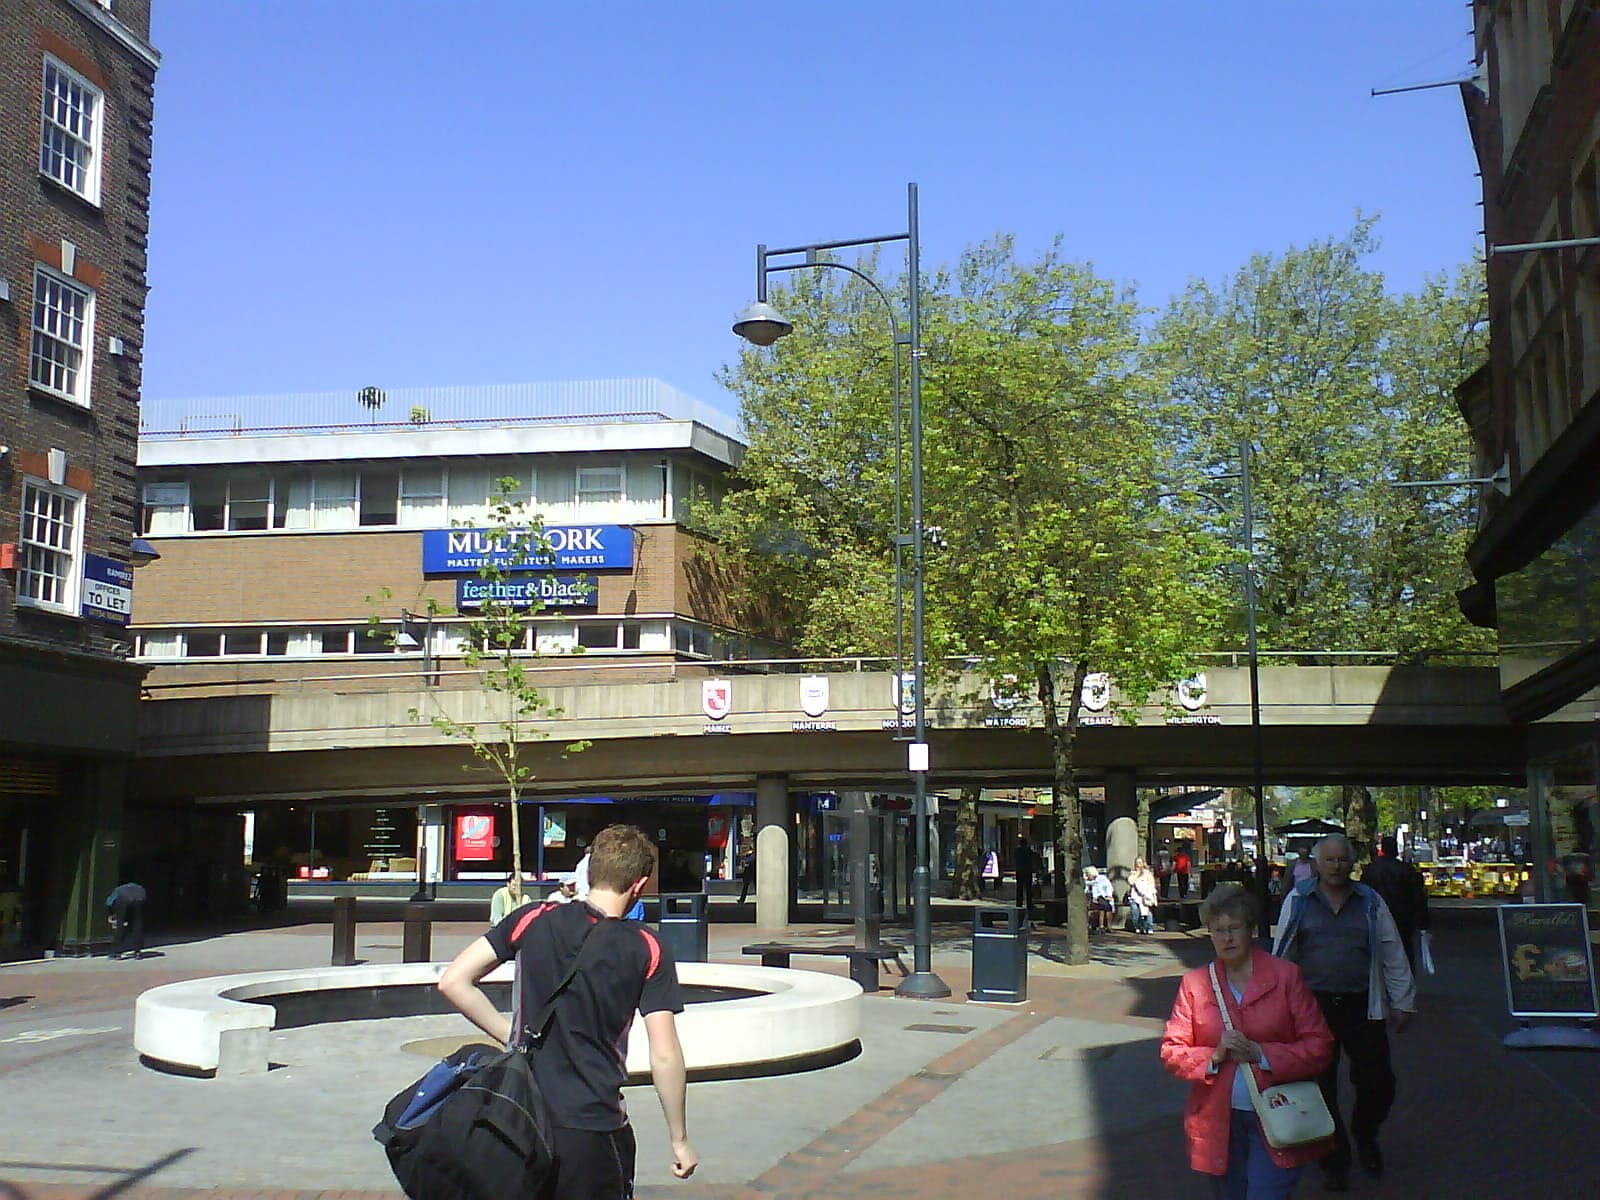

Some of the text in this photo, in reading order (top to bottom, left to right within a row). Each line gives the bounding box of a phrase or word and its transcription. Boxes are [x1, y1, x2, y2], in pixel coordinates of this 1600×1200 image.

[561, 555, 604, 565] MAKERS
[89, 592, 126, 610] TO LET
[985, 718, 1027, 726] WATFORD
